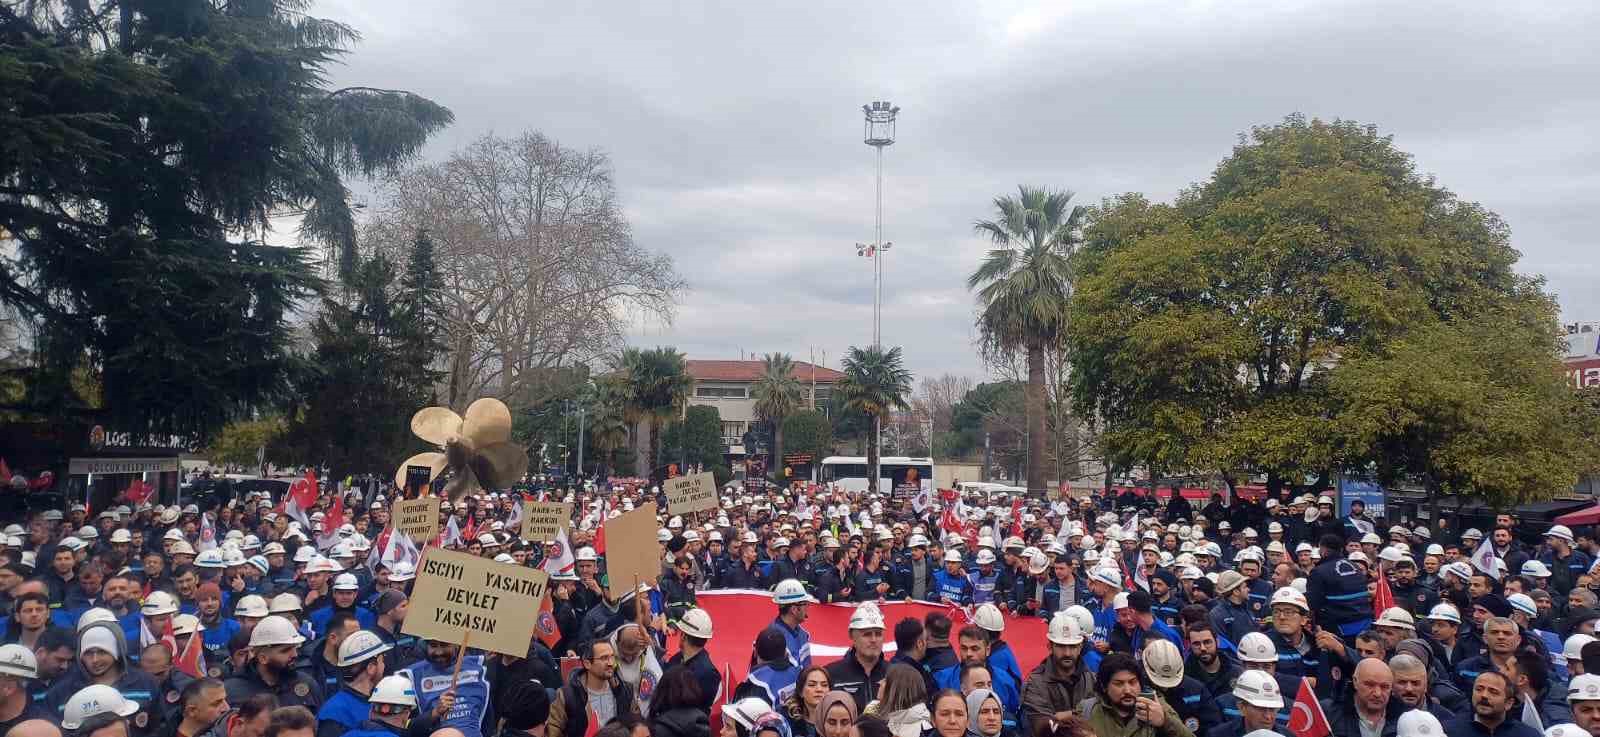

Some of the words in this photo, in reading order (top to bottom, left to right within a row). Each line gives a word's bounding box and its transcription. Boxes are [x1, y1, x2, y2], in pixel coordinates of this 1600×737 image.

[423, 559, 464, 581] ISCIYI
[485, 571, 542, 598] YASATKI
[446, 586, 499, 610] DEVLET
[434, 607, 497, 634] YASASIN
